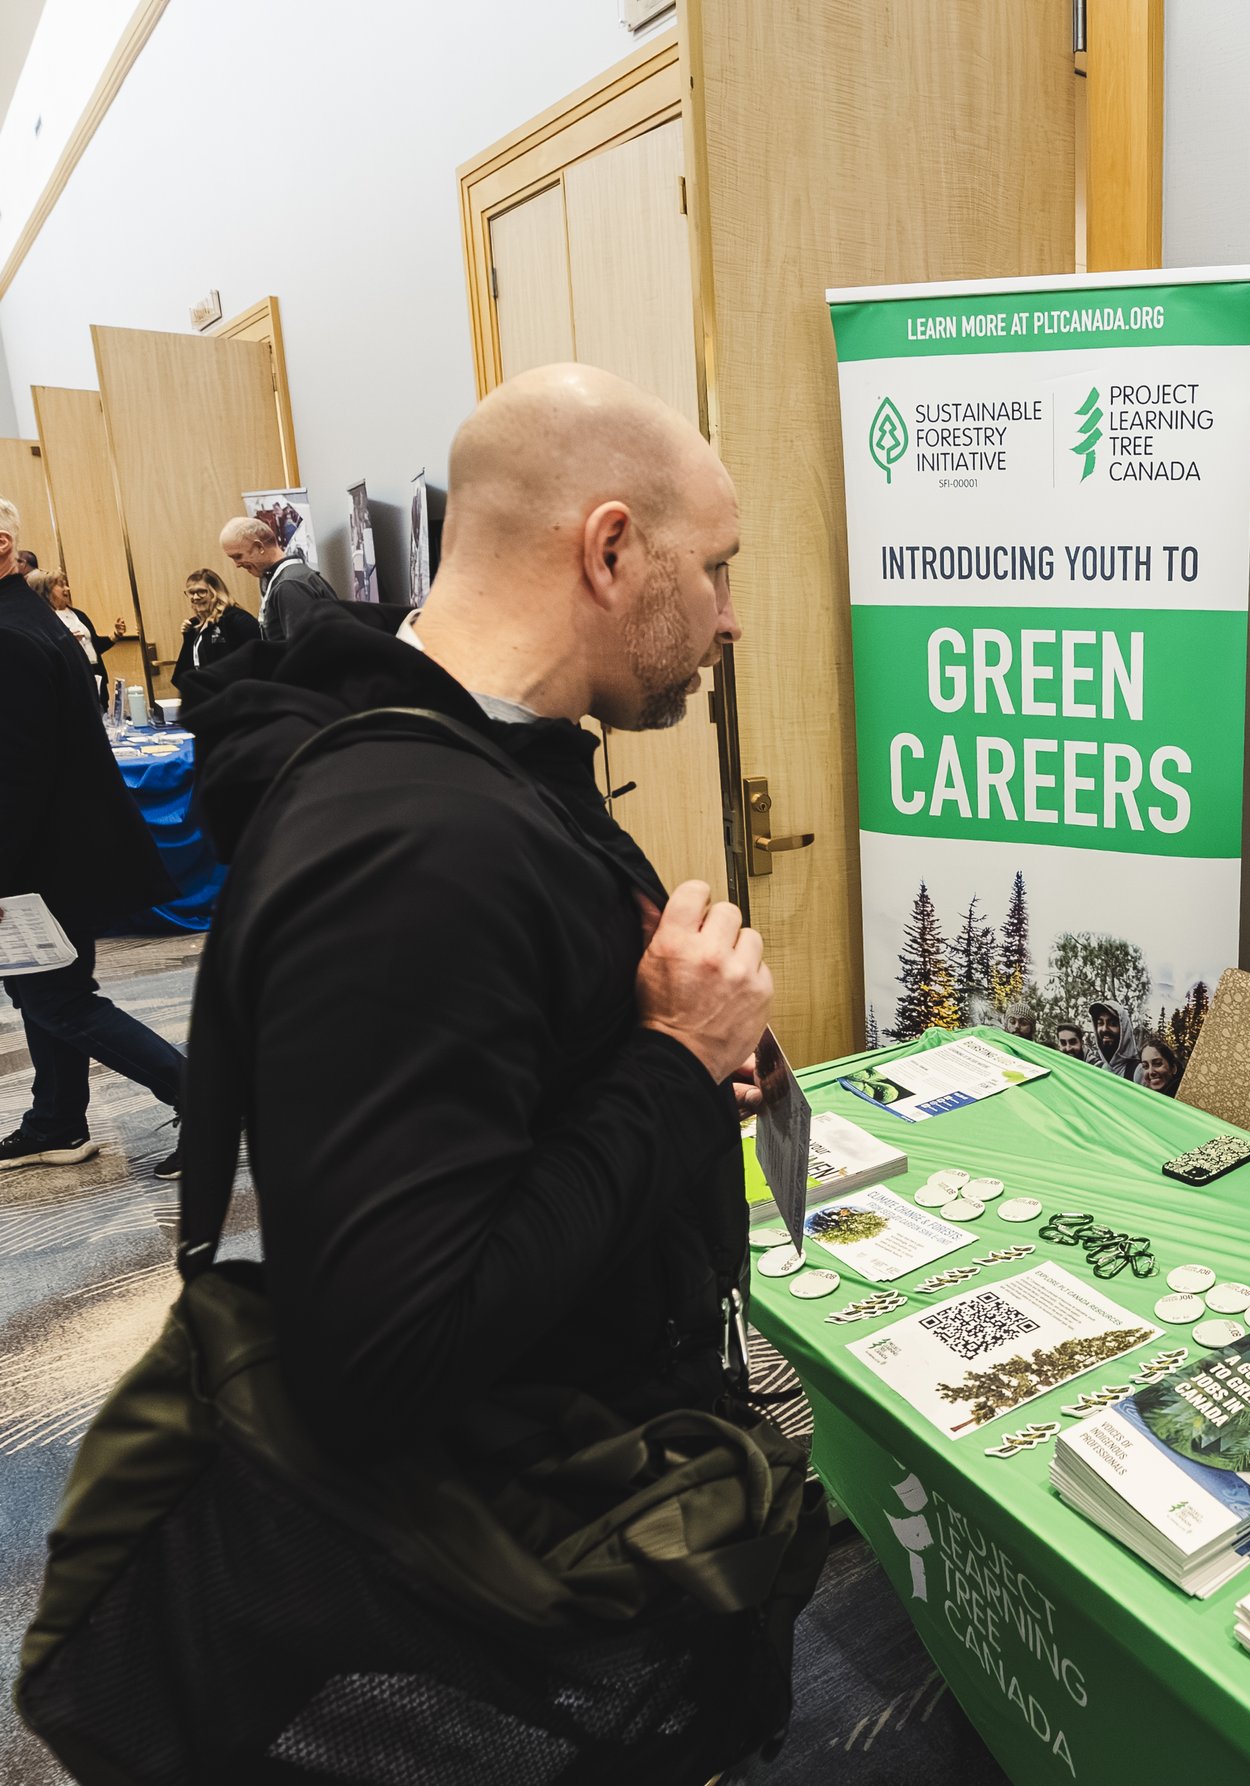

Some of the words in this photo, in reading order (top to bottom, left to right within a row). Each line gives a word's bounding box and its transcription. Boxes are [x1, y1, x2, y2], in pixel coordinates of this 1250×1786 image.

[908, 315, 957, 340] LEARN
[961, 312, 1006, 337] MORE
[1010, 311, 1029, 335] AT
[1033, 306, 1165, 333] PLTCANADA.ORG
[1110, 384, 1199, 405] PROJECT
[915, 400, 1042, 423] SUSTAINABLE
[1110, 410, 1214, 431] LEARNING
[916, 427, 1007, 447] FORESTRY
[1110, 436, 1153, 456] TREE
[917, 451, 1006, 472] INITIATIVE
[1109, 461, 1201, 482] CANADA
[938, 478, 978, 488] SFI-00001
[881, 545, 1054, 581] INTRODUCING
[1065, 545, 1150, 582] YOUTH
[1163, 546, 1199, 582] TO
[926, 627, 1145, 721] GREEN
[889, 732, 1193, 835] CAREERS
[1197, 1268, 1211, 1276] JOB
[1209, 1362, 1232, 1379] TO
[1224, 1355, 1242, 1366] A
[1174, 1382, 1229, 1428] CANADA
[1190, 1372, 1229, 1401] JOBS
[1222, 1397, 1245, 1414] IN
[1090, 1427, 1127, 1460] INDIGENOUS
[1101, 1421, 1124, 1441] VOICES
[1120, 1439, 1133, 1449] OF
[1080, 1432, 1127, 1475] PROFESSIONALS
[936, 1512, 1087, 1707] LEARNING
[940, 1551, 1001, 1652] TREE
[944, 1599, 1076, 1778] CANADA
